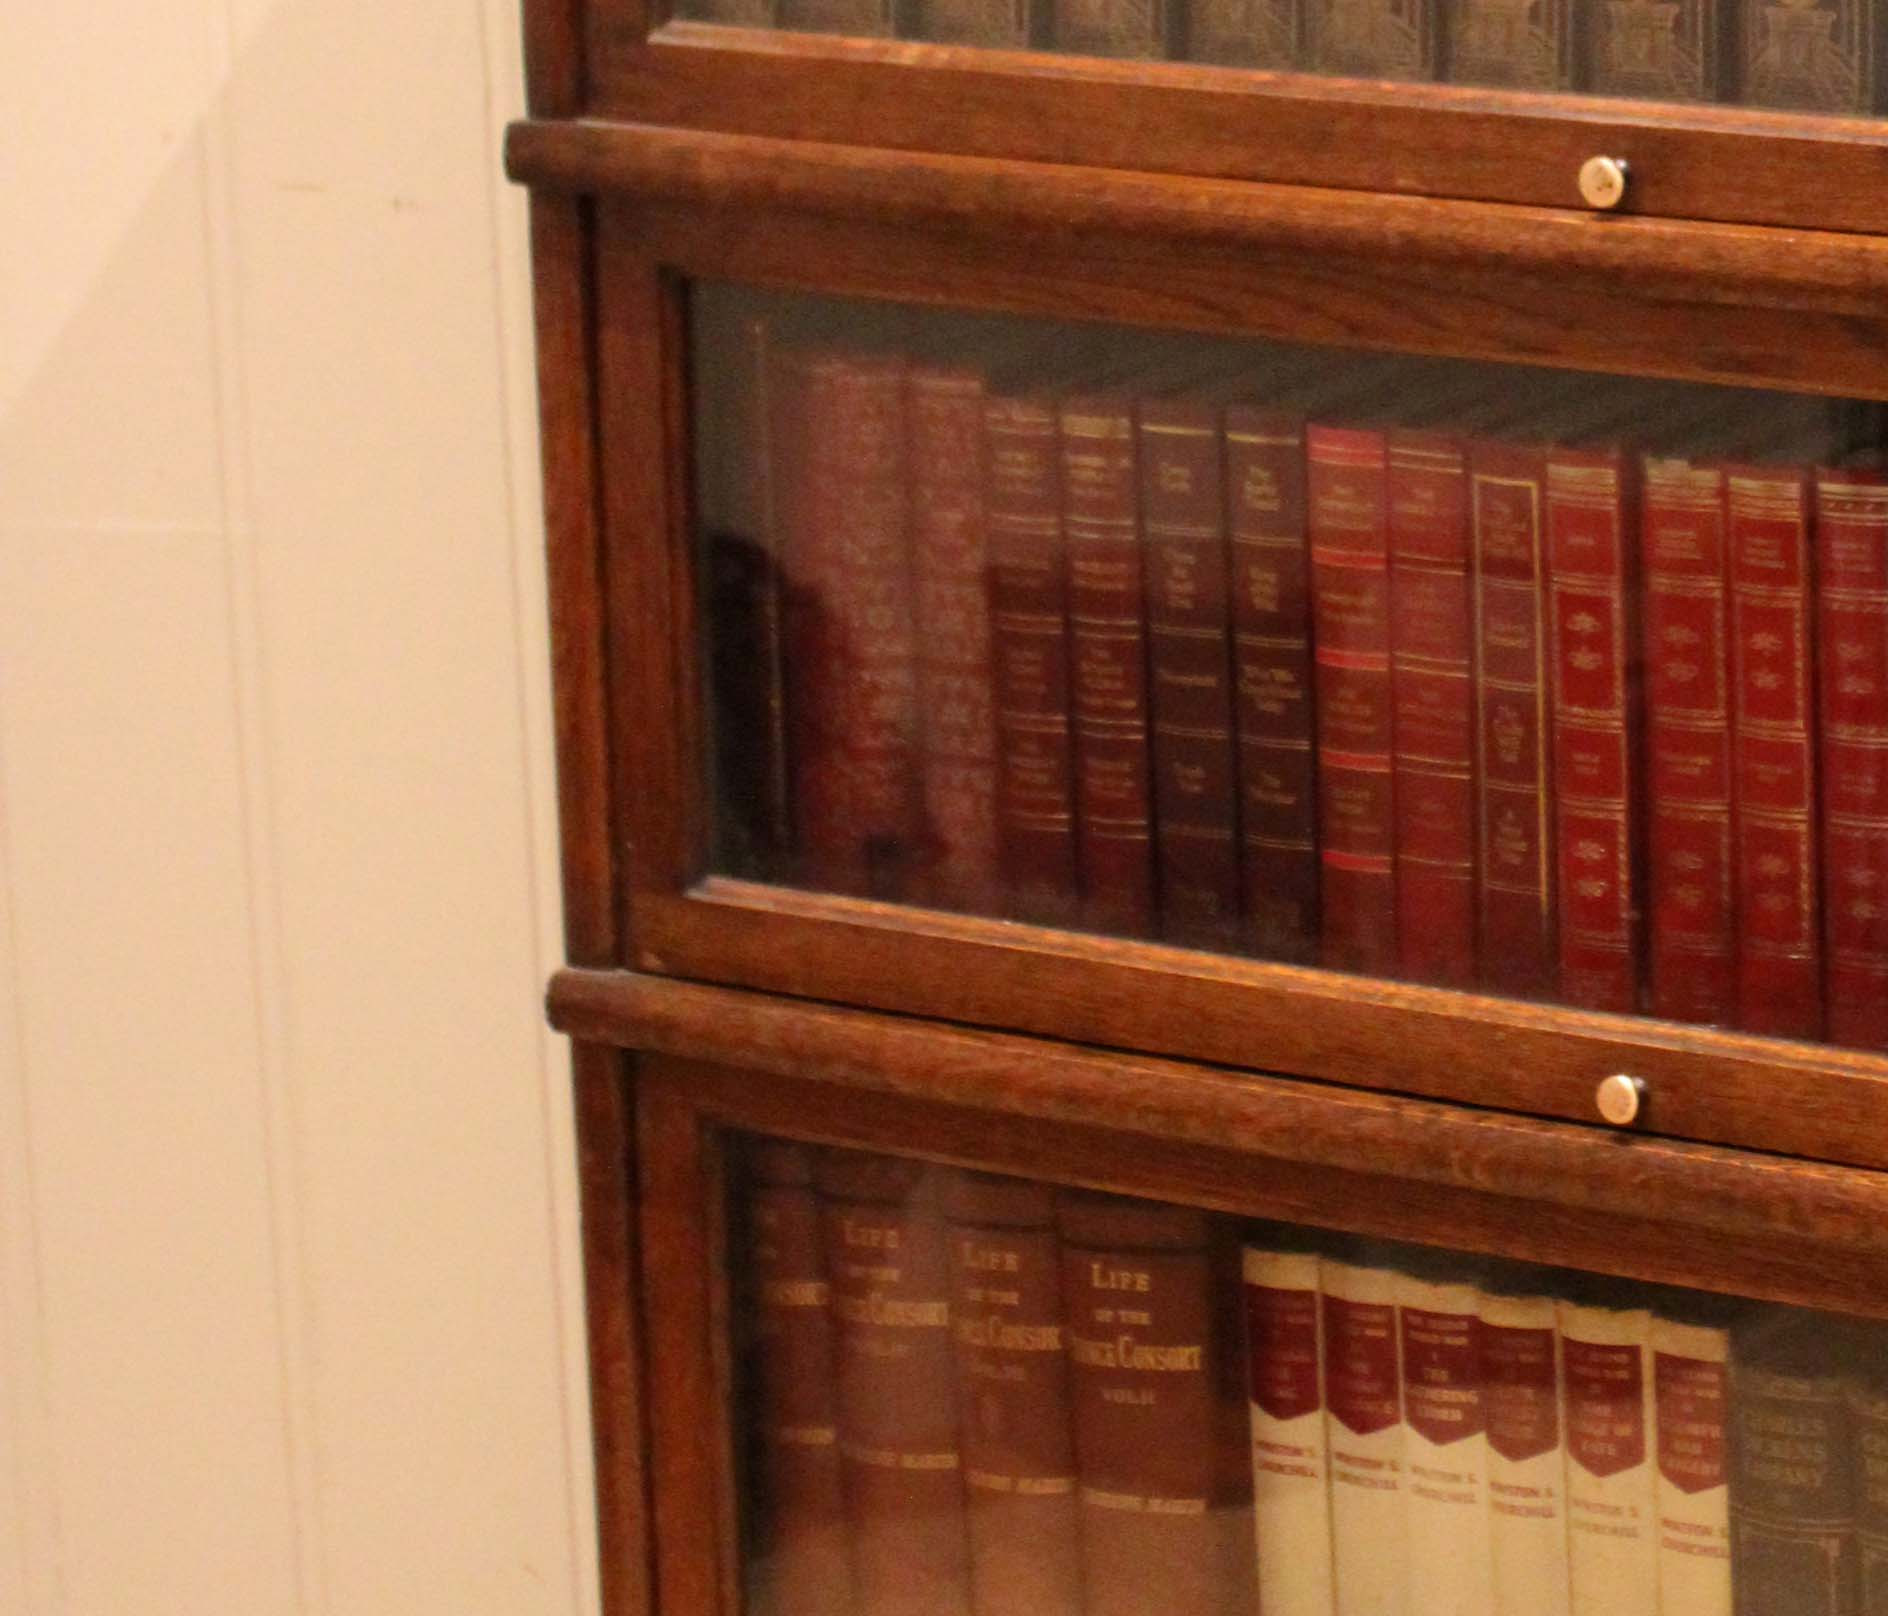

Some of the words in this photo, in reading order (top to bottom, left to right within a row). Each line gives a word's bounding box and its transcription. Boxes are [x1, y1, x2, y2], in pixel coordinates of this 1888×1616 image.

[962, 1240, 1020, 1272] LIFE
[1090, 1261, 1151, 1292] LIFE
[1117, 1333, 1204, 1373] CONSORT
